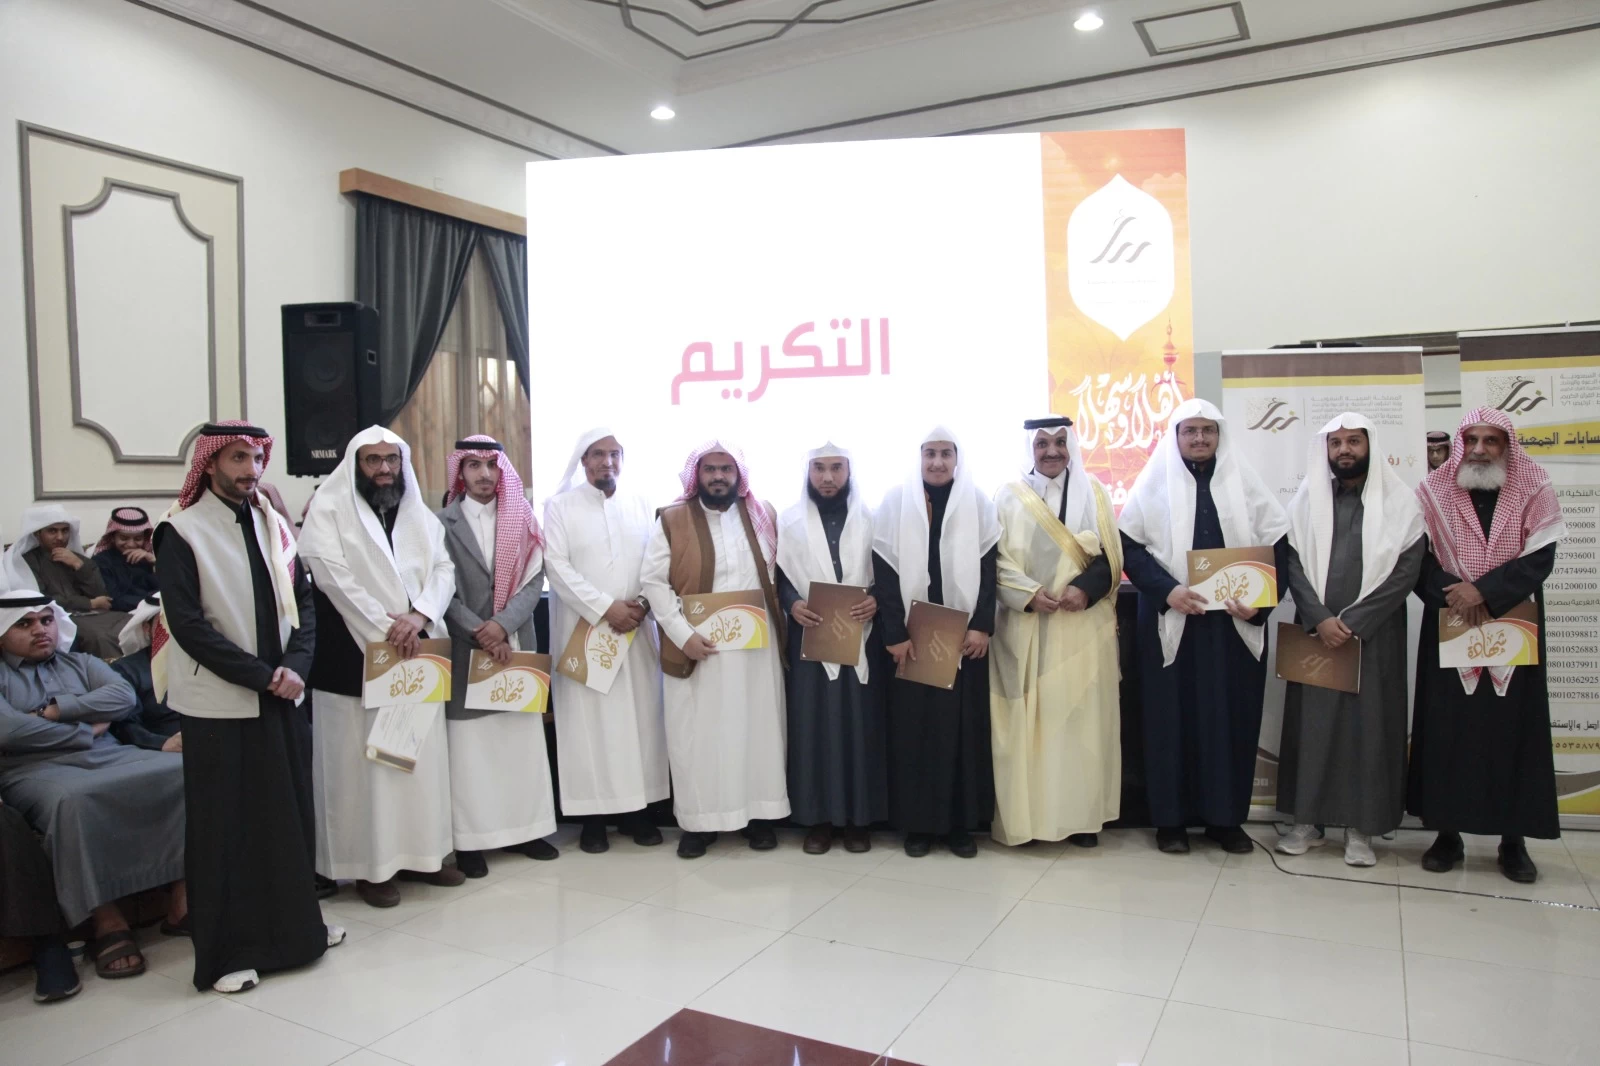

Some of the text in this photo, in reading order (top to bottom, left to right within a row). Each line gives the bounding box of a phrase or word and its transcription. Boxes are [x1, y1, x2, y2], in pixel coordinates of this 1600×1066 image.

[671, 317, 890, 405] التكريم
[1518, 431, 1600, 450] سابات الجمعية
[1387, 454, 1401, 466] رؤ
[1562, 506, 1595, 514] 0065007
[1554, 552, 1596, 560] 327936001
[1545, 614, 1598, 623] 08010007058
[1546, 629, 1598, 638] 08010398812
[1467, 629, 1507, 659] شهادة
[1546, 645, 1598, 653] 08010526883
[1547, 660, 1598, 668] 08010379911
[390, 664, 425, 698] شهادة
[1548, 675, 1599, 684] 08010362925
[490, 672, 525, 703] شهادة
[1548, 690, 1599, 699] 08010278816
[1552, 742, 1600, 750] ٥٥٣٥٨٧٩
